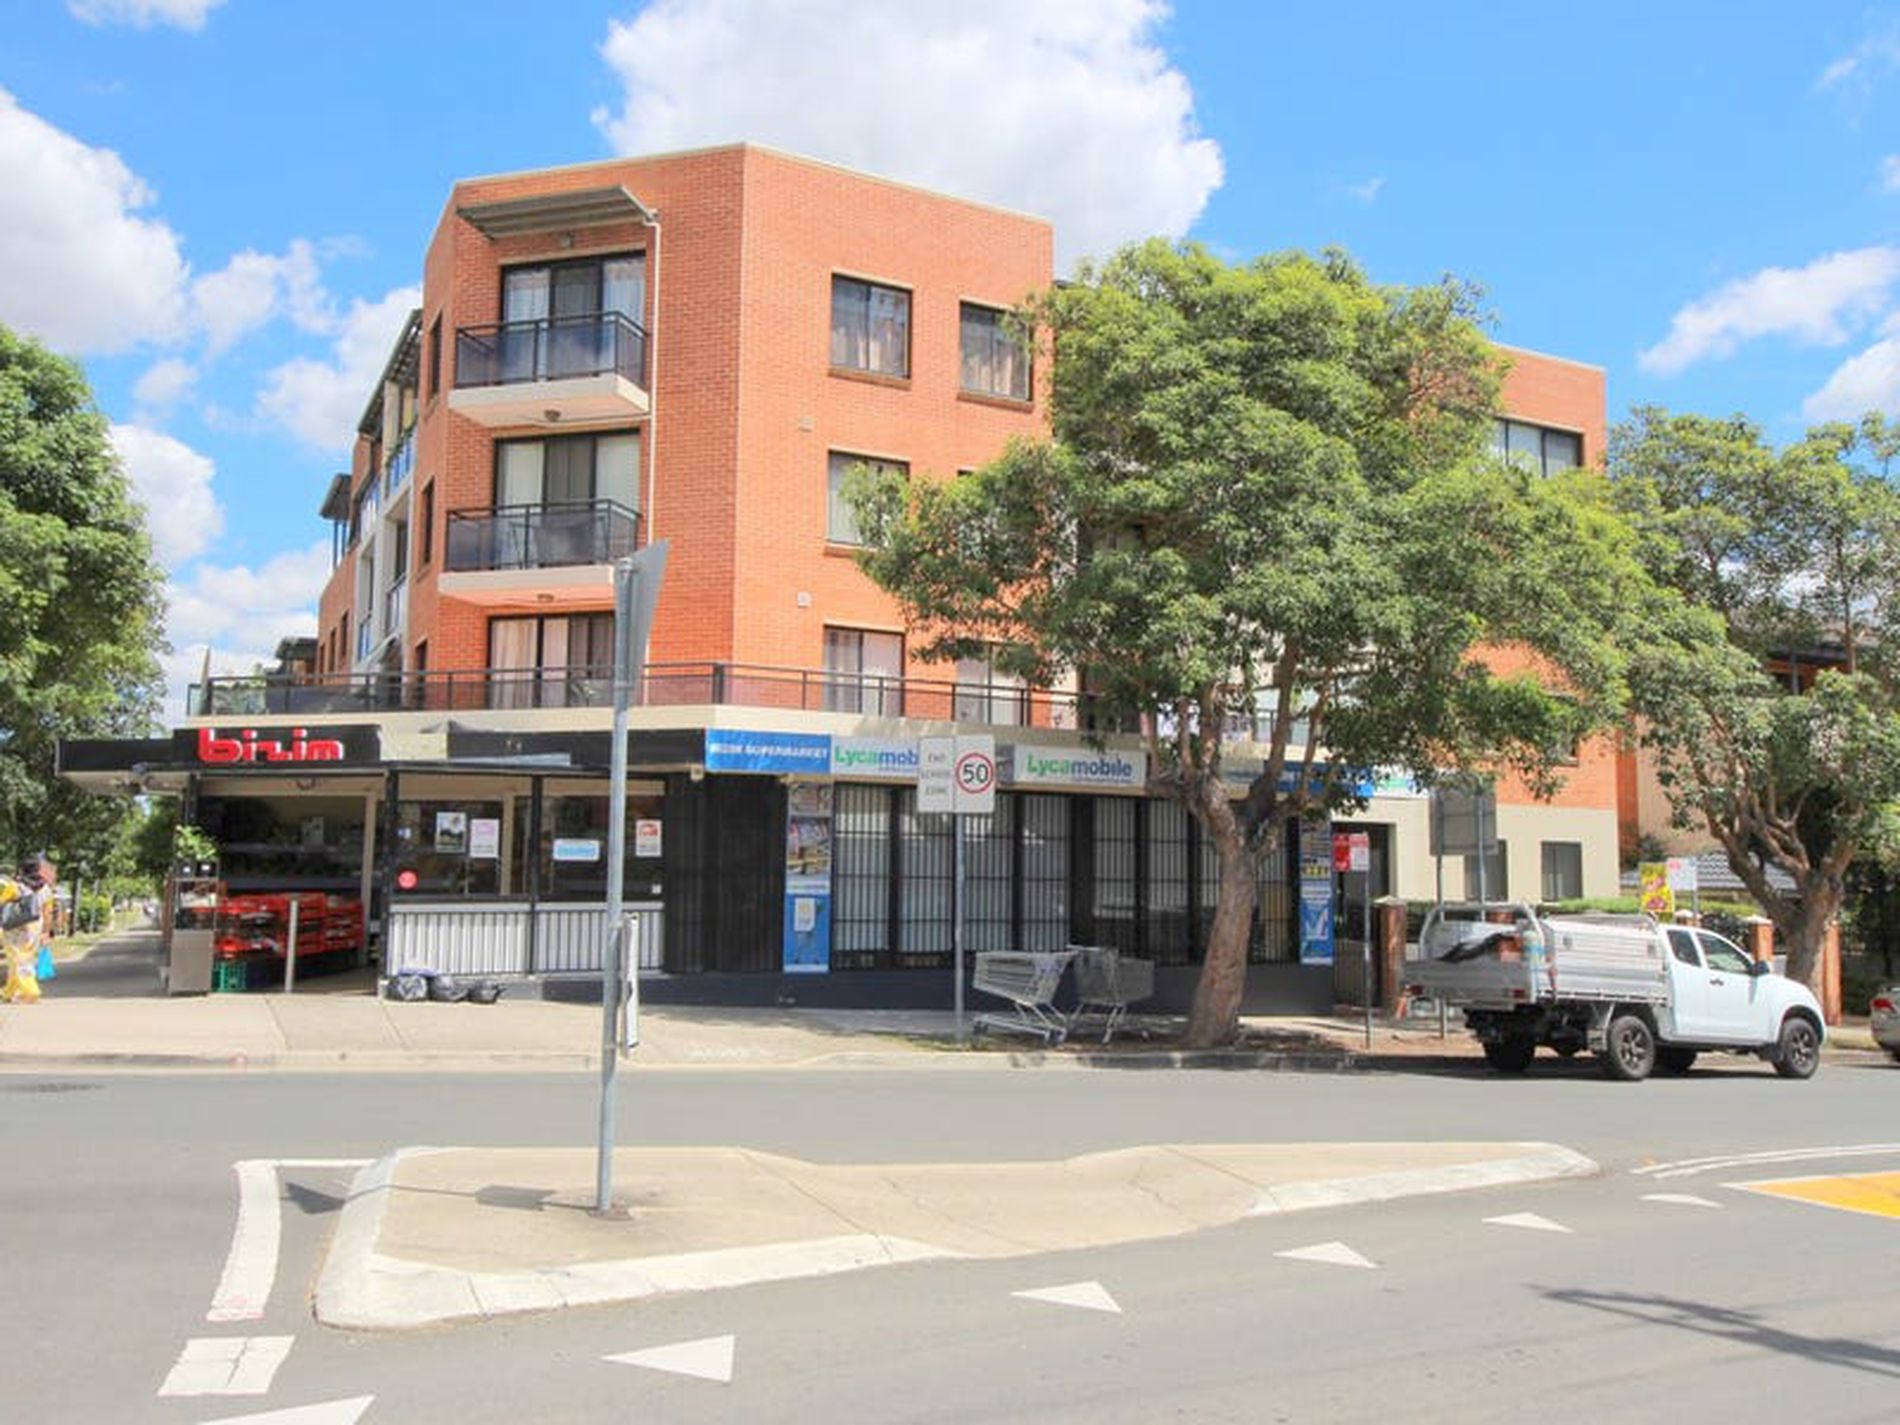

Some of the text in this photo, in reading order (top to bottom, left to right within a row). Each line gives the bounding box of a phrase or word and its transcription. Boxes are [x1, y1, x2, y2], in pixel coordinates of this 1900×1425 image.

[835, 745, 919, 766] Lycamob
[1026, 754, 1133, 778] Lycamobile
[963, 763, 989, 784] 50
